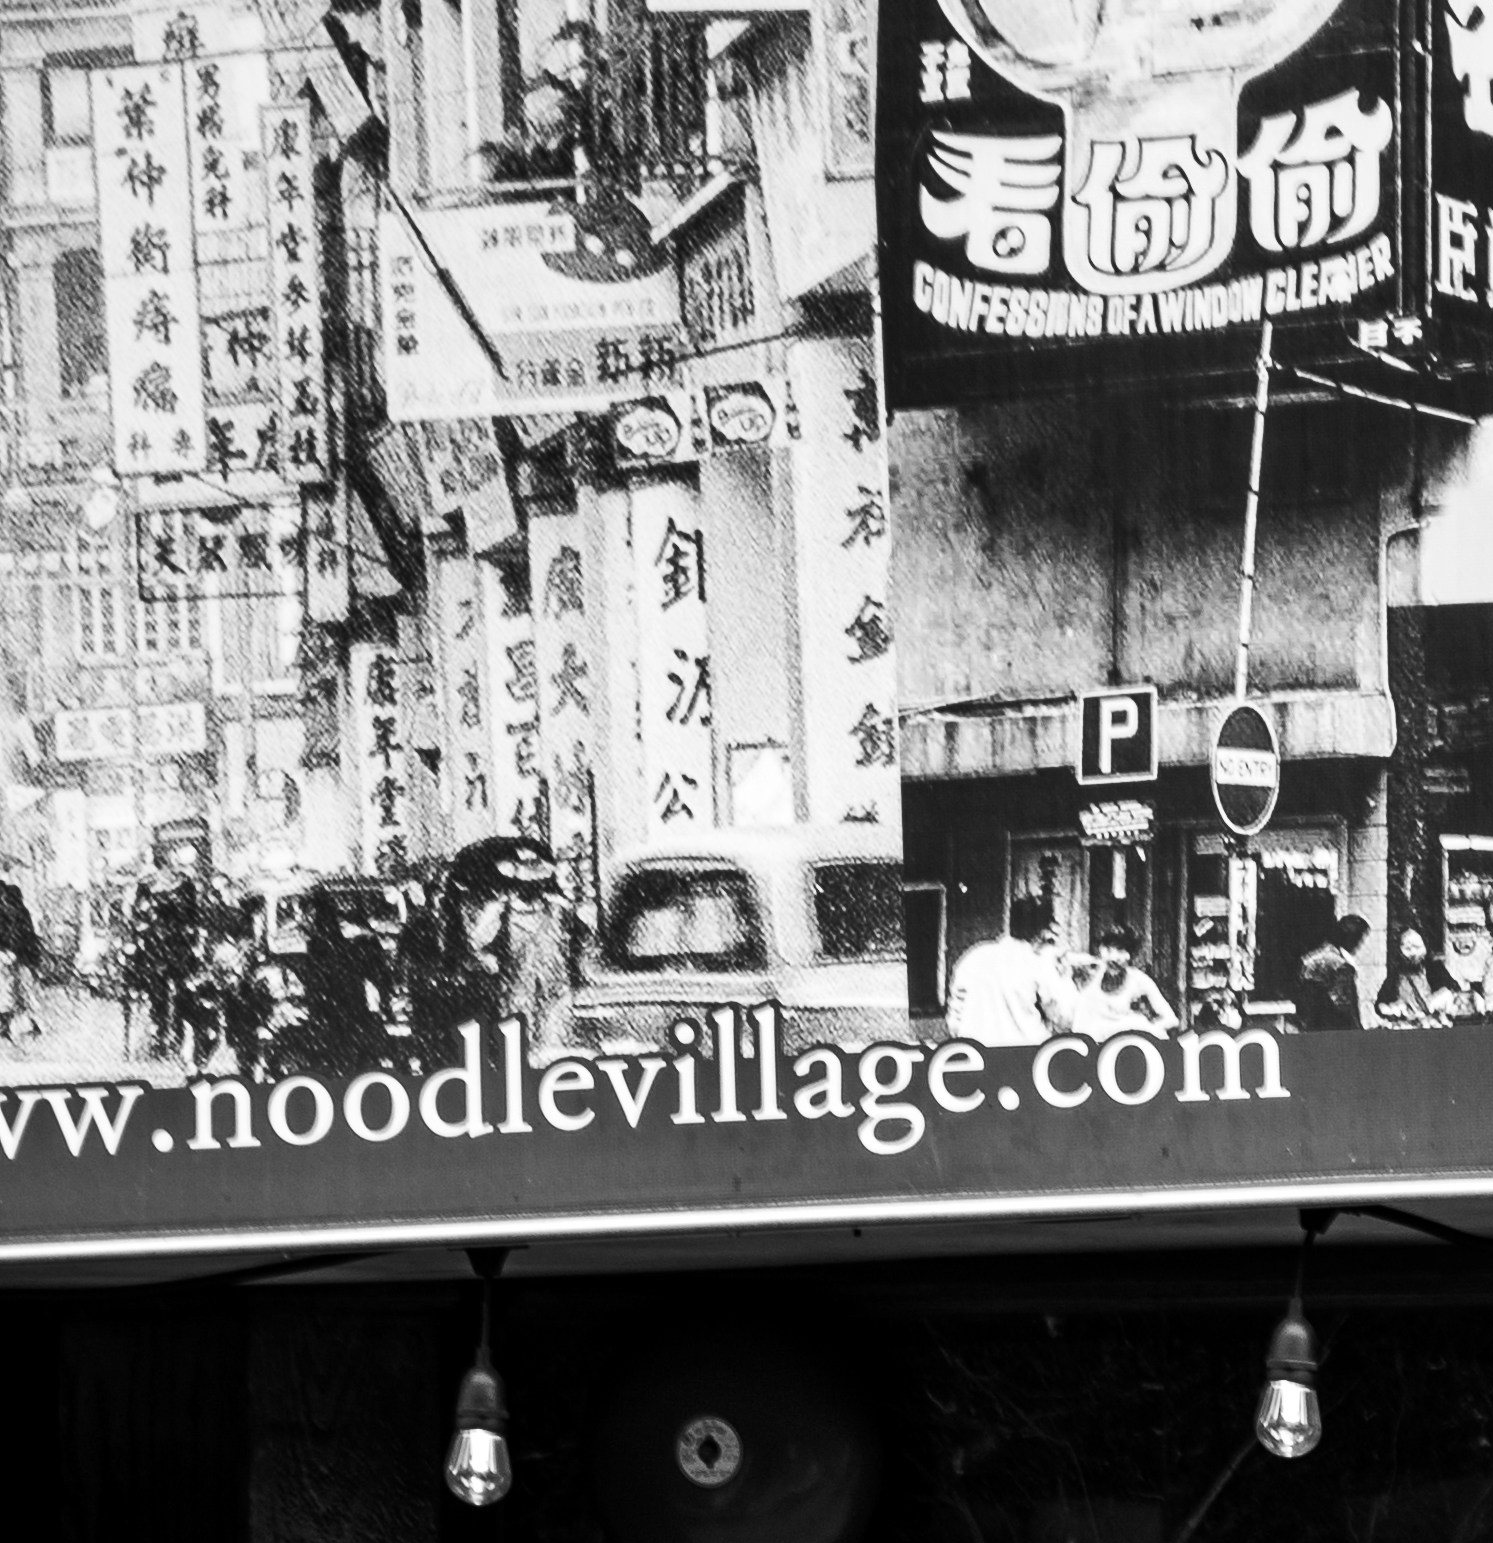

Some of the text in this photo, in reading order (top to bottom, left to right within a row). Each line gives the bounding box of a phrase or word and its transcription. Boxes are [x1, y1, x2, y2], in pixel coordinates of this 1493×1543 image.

[912, 260, 1105, 337] CONFESSIONS
[1106, 296, 1139, 334] OF
[1158, 275, 1266, 334] WINDOW
[1264, 233, 1395, 315] CLEANER
[1100, 697, 1139, 774] P
